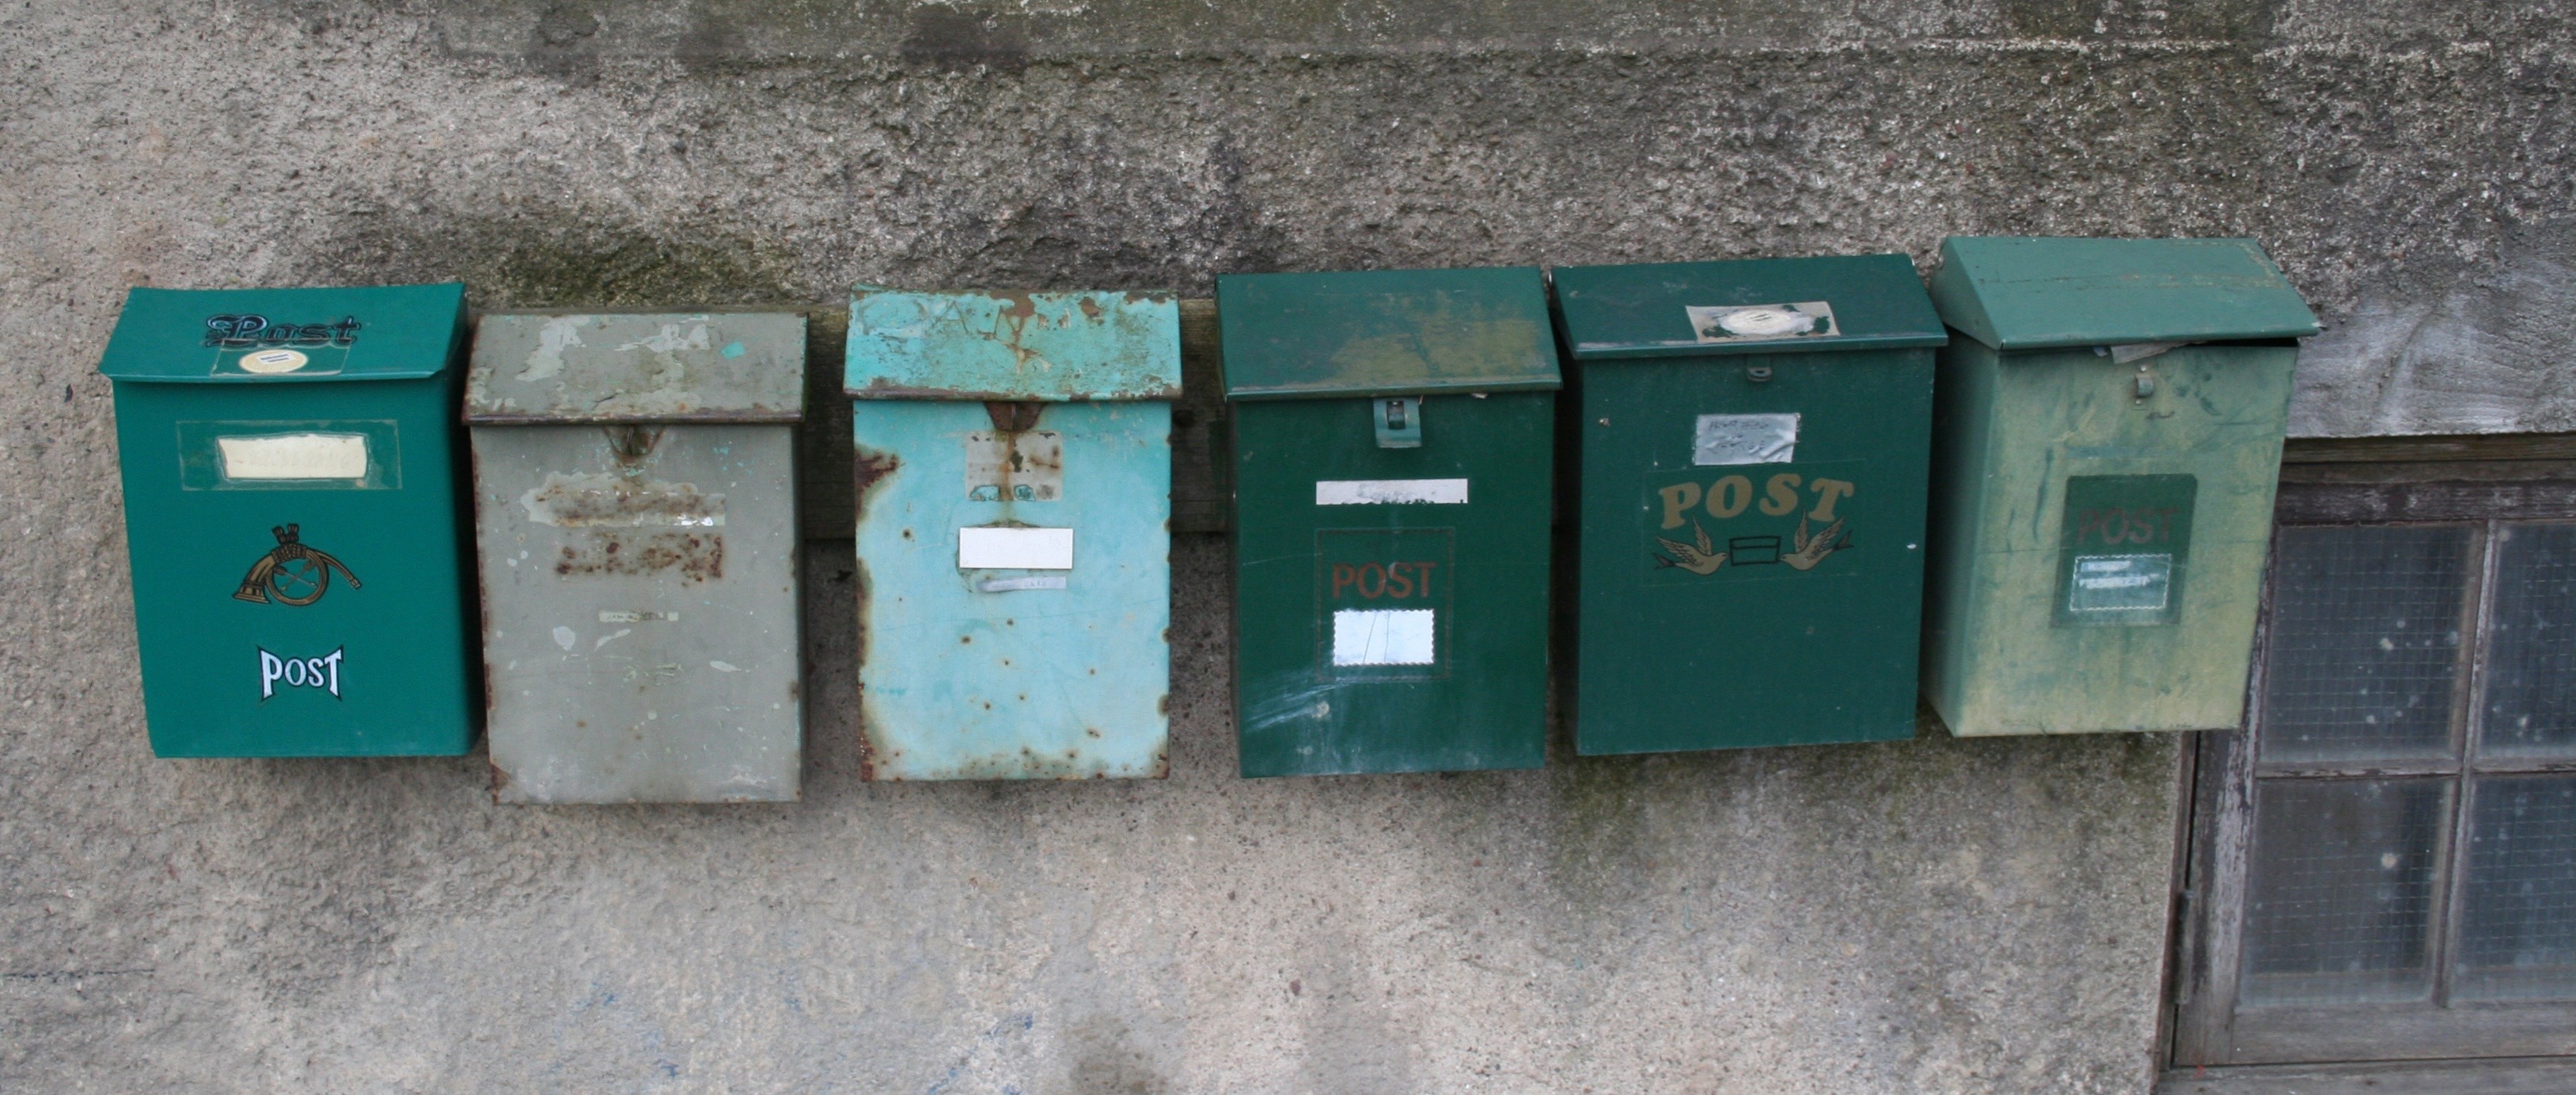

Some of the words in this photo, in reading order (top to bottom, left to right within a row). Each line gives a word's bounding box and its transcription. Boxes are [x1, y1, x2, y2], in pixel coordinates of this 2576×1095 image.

[205, 314, 362, 348] Post
[1659, 473, 1854, 529] POST
[2076, 506, 2179, 546] POST
[1332, 562, 1437, 599] POST
[258, 646, 343, 701] POST
